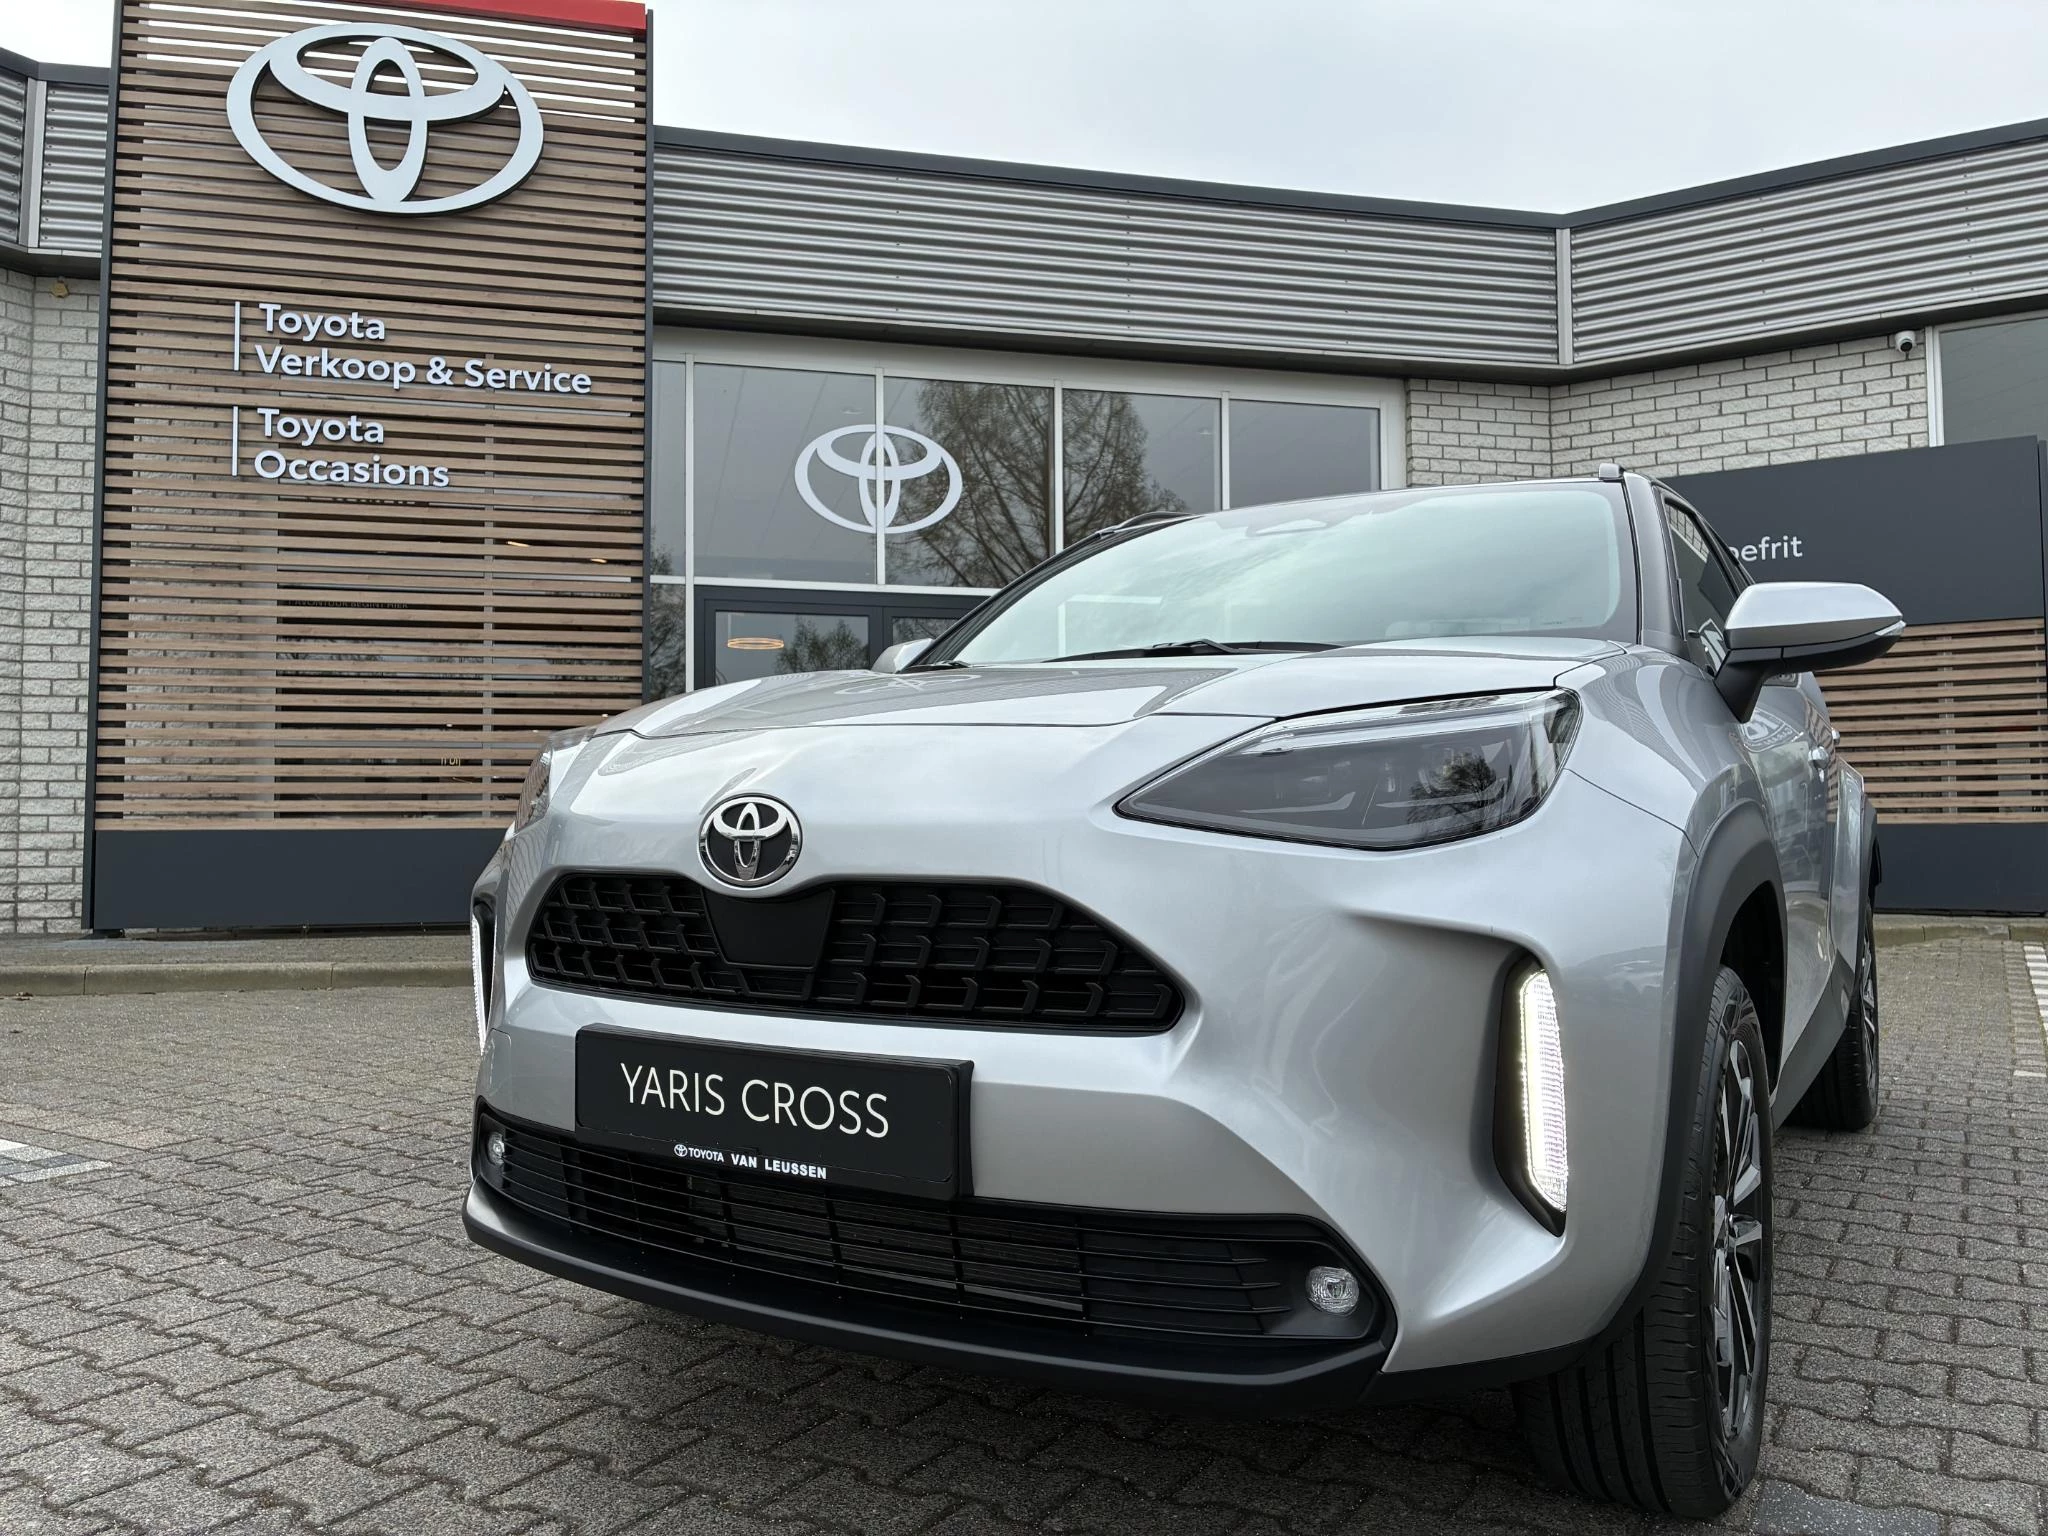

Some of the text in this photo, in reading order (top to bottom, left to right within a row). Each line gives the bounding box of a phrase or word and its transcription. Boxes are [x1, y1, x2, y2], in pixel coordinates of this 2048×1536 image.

[258, 303, 386, 342] Toyota
[254, 344, 592, 394] Verkoop & Service
[257, 407, 385, 447] Toyota
[254, 449, 450, 487] Occasions
[620, 1062, 889, 1138] YARIS CROSS
[688, 1147, 827, 1180] TOYOTA VAN LEUSSEN
